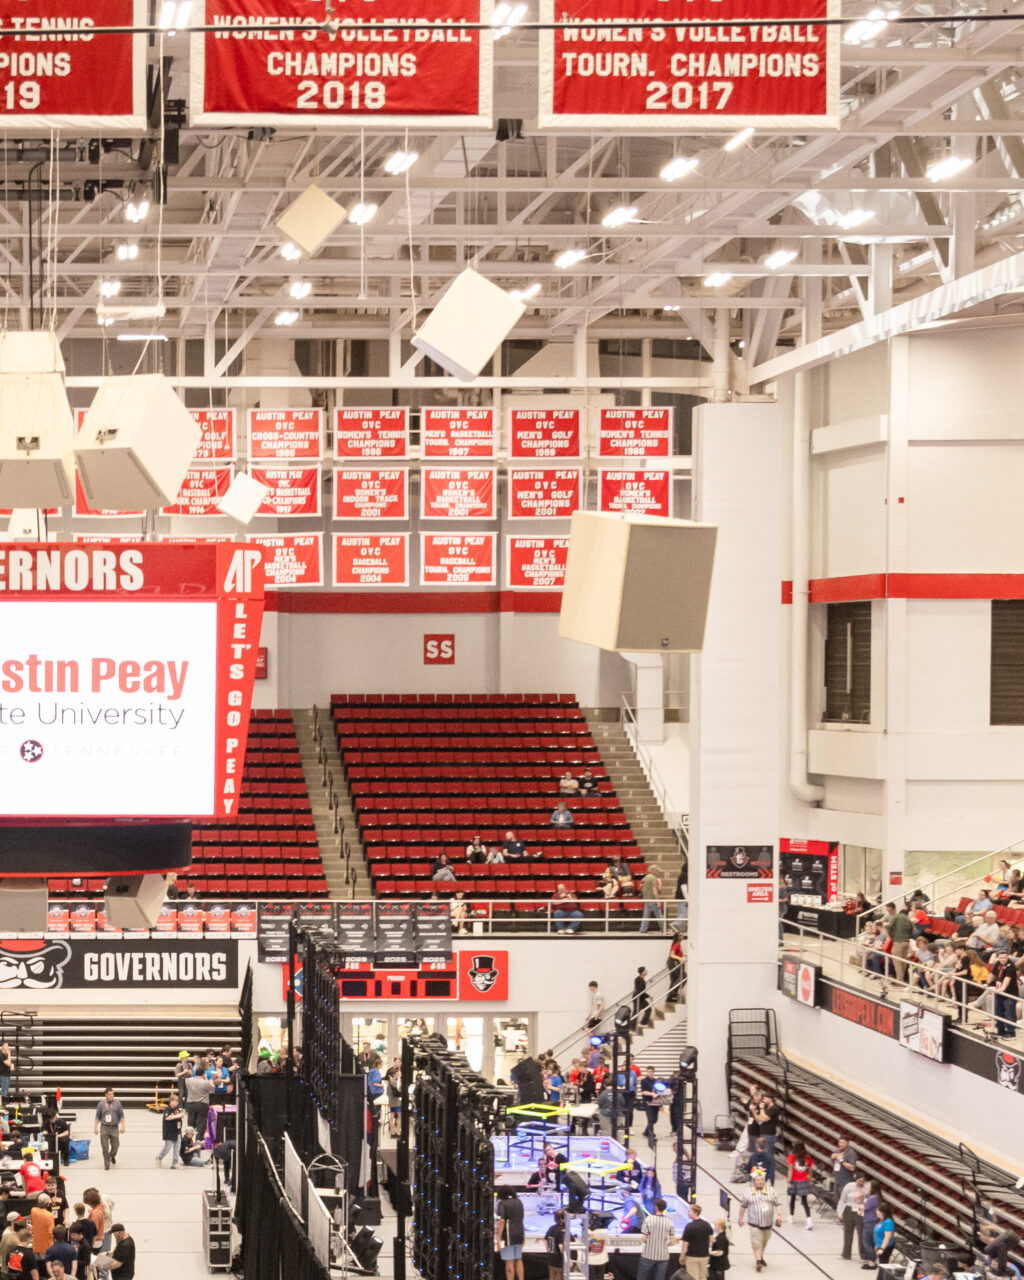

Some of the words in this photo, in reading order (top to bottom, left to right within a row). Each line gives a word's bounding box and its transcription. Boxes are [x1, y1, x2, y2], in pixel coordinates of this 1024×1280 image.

[12, 17, 95, 41] TENNIS
[213, 15, 317, 40] WOMEN'S
[328, 18, 472, 42] VOLLEYBALL
[561, 18, 665, 42] WOMEN'S
[675, 18, 819, 42] VOLLEYBALL
[267, 53, 416, 76] CHAMPIONS
[562, 53, 655, 76] TOURN.
[670, 53, 819, 77] CHAMPIONS
[297, 81, 386, 109] 2018
[646, 82, 734, 110] 2017
[362, 421, 381, 429] OVC
[536, 421, 555, 429] OVC
[348, 440, 395, 448] CHAMPIONS
[522, 440, 569, 448] CHAMPIONS
[521, 500, 570, 508] CHAMPIONS
[229, 603, 251, 680] LET'S
[426, 640, 453, 658] SS
[92, 658, 189, 700] Peay
[38, 702, 185, 729] University
[227, 690, 242, 726] GO
[223, 738, 239, 814] PEAY
[84, 952, 227, 981] GOVERNORS
